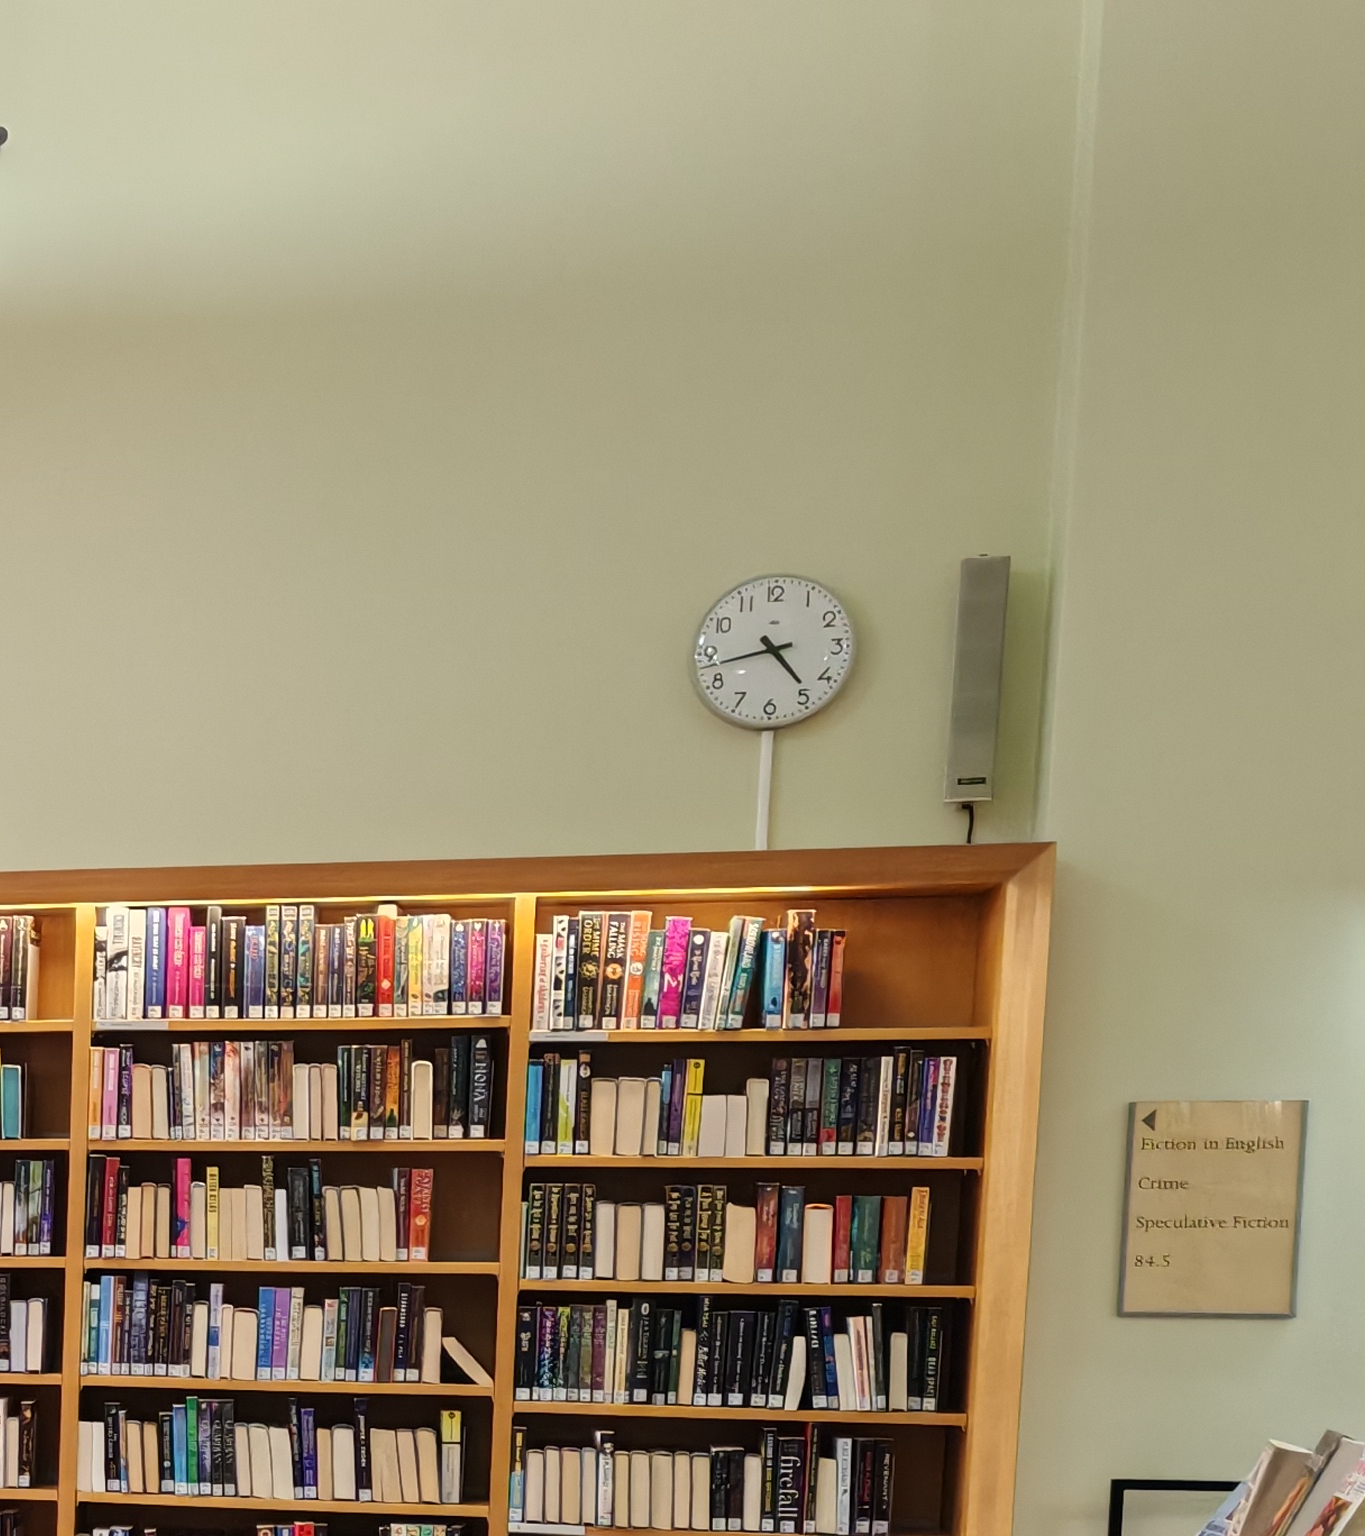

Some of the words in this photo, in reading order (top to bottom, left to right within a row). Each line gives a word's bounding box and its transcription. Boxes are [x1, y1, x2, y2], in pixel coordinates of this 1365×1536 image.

[767, 585, 784, 602] 12
[807, 591, 810, 607] 1
[740, 596, 753, 612] 11
[716, 617, 731, 633] 10
[823, 611, 836, 628] 2
[703, 646, 717, 661] 9
[831, 638, 843, 655] 3
[712, 673, 723, 689] 8
[817, 667, 832, 684] 4
[734, 692, 746, 709] 7
[797, 689, 811, 705] 5
[763, 699, 776, 715] 6
[608, 921, 619, 958] FALLING
[1141, 1138, 1196, 1150] Fiction
[1204, 1139, 1218, 1150] in
[1226, 1136, 1284, 1153] English
[1138, 1177, 1189, 1189] Crime
[1136, 1214, 1227, 1232] Speculative
[1233, 1216, 1289, 1228] Fiction
[1134, 1254, 1170, 1267] 84.5
[778, 1456, 801, 1517] firefall
